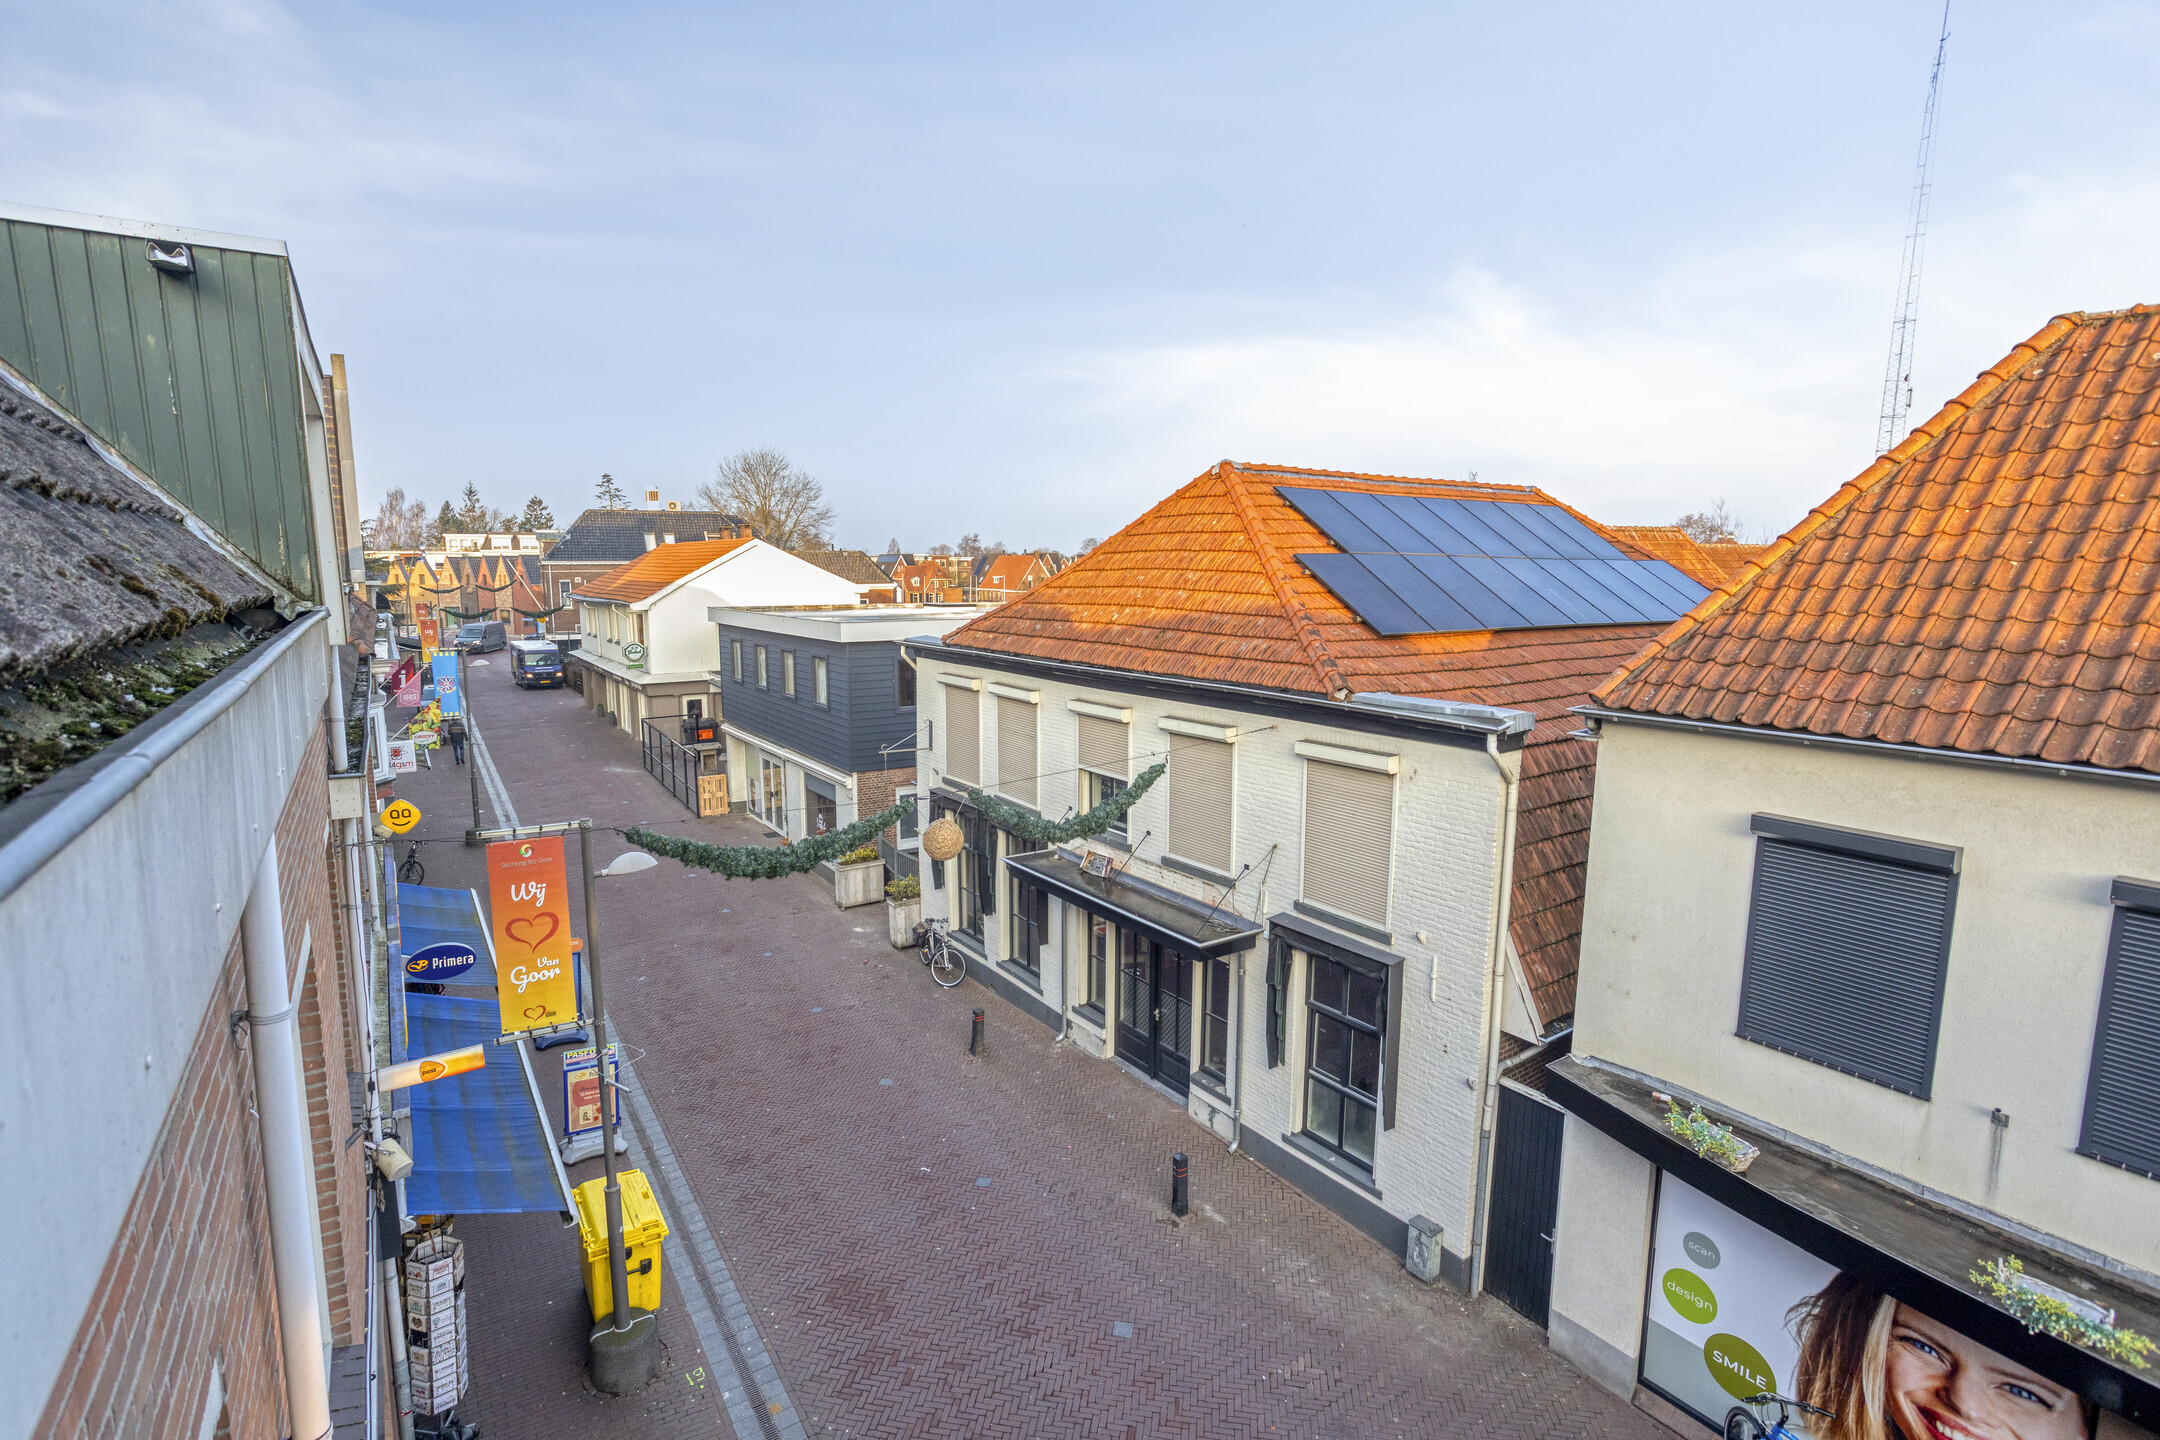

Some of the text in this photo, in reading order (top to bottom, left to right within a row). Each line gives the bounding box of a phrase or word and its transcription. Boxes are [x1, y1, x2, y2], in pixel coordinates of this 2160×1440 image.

[500, 860, 527, 869] Stichting
[538, 856, 554, 864] Goor
[510, 881, 547, 907] Wij
[432, 954, 474, 970] Primera
[537, 956, 560, 968] Van
[510, 966, 561, 994] Goor
[1687, 1240, 1716, 1260] scan
[1666, 1281, 1713, 1312] design
[1712, 1350, 1768, 1391] SMILE
